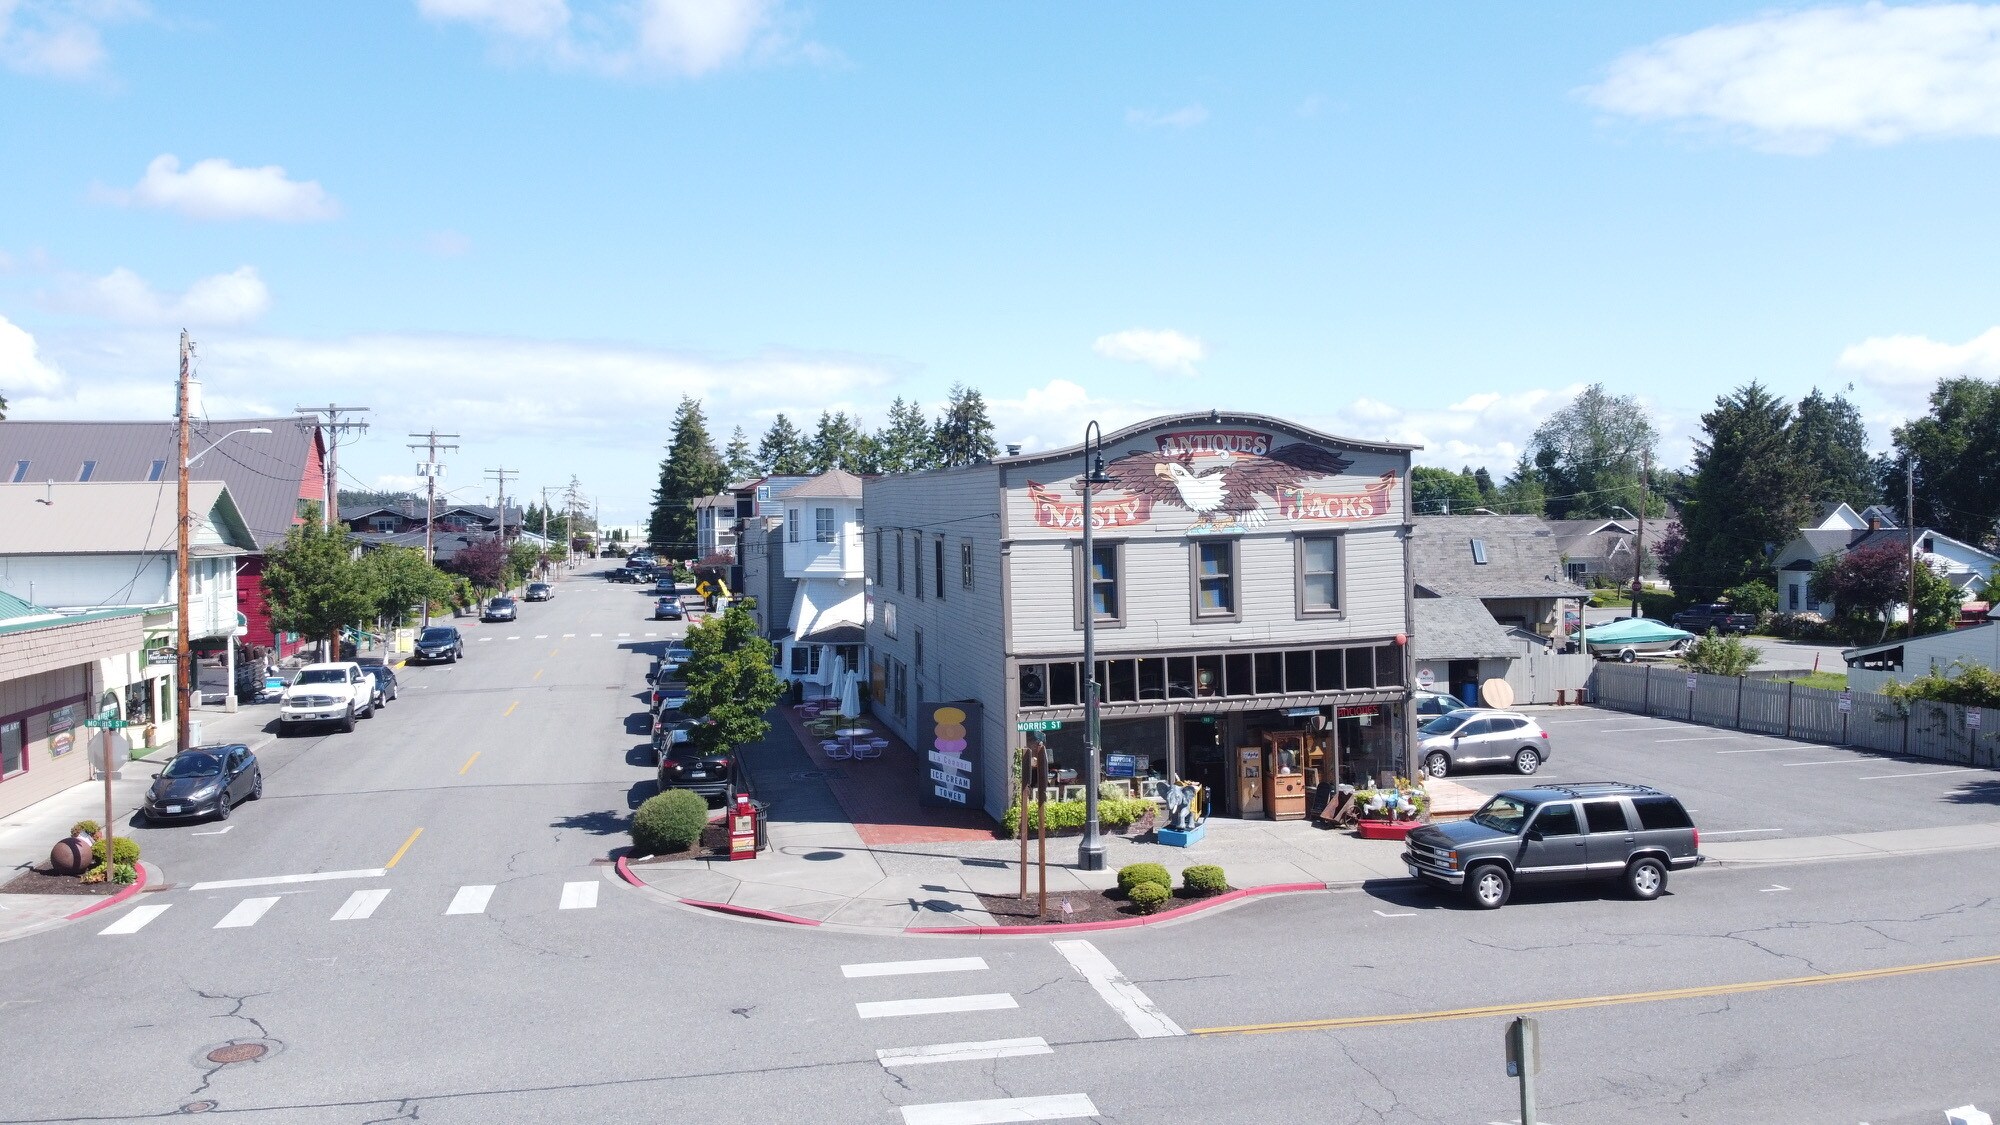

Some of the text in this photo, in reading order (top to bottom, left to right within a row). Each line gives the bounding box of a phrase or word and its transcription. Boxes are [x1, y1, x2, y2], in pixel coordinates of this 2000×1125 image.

[1161, 434, 1267, 460] ANTIQUES
[1042, 488, 1374, 530] NASTY JACKS
[115, 720, 123, 728] ST
[1017, 720, 1061, 731] MORRIS ST
[932, 770, 968, 787] ICE CREAM
[940, 788, 962, 801] TOWER
